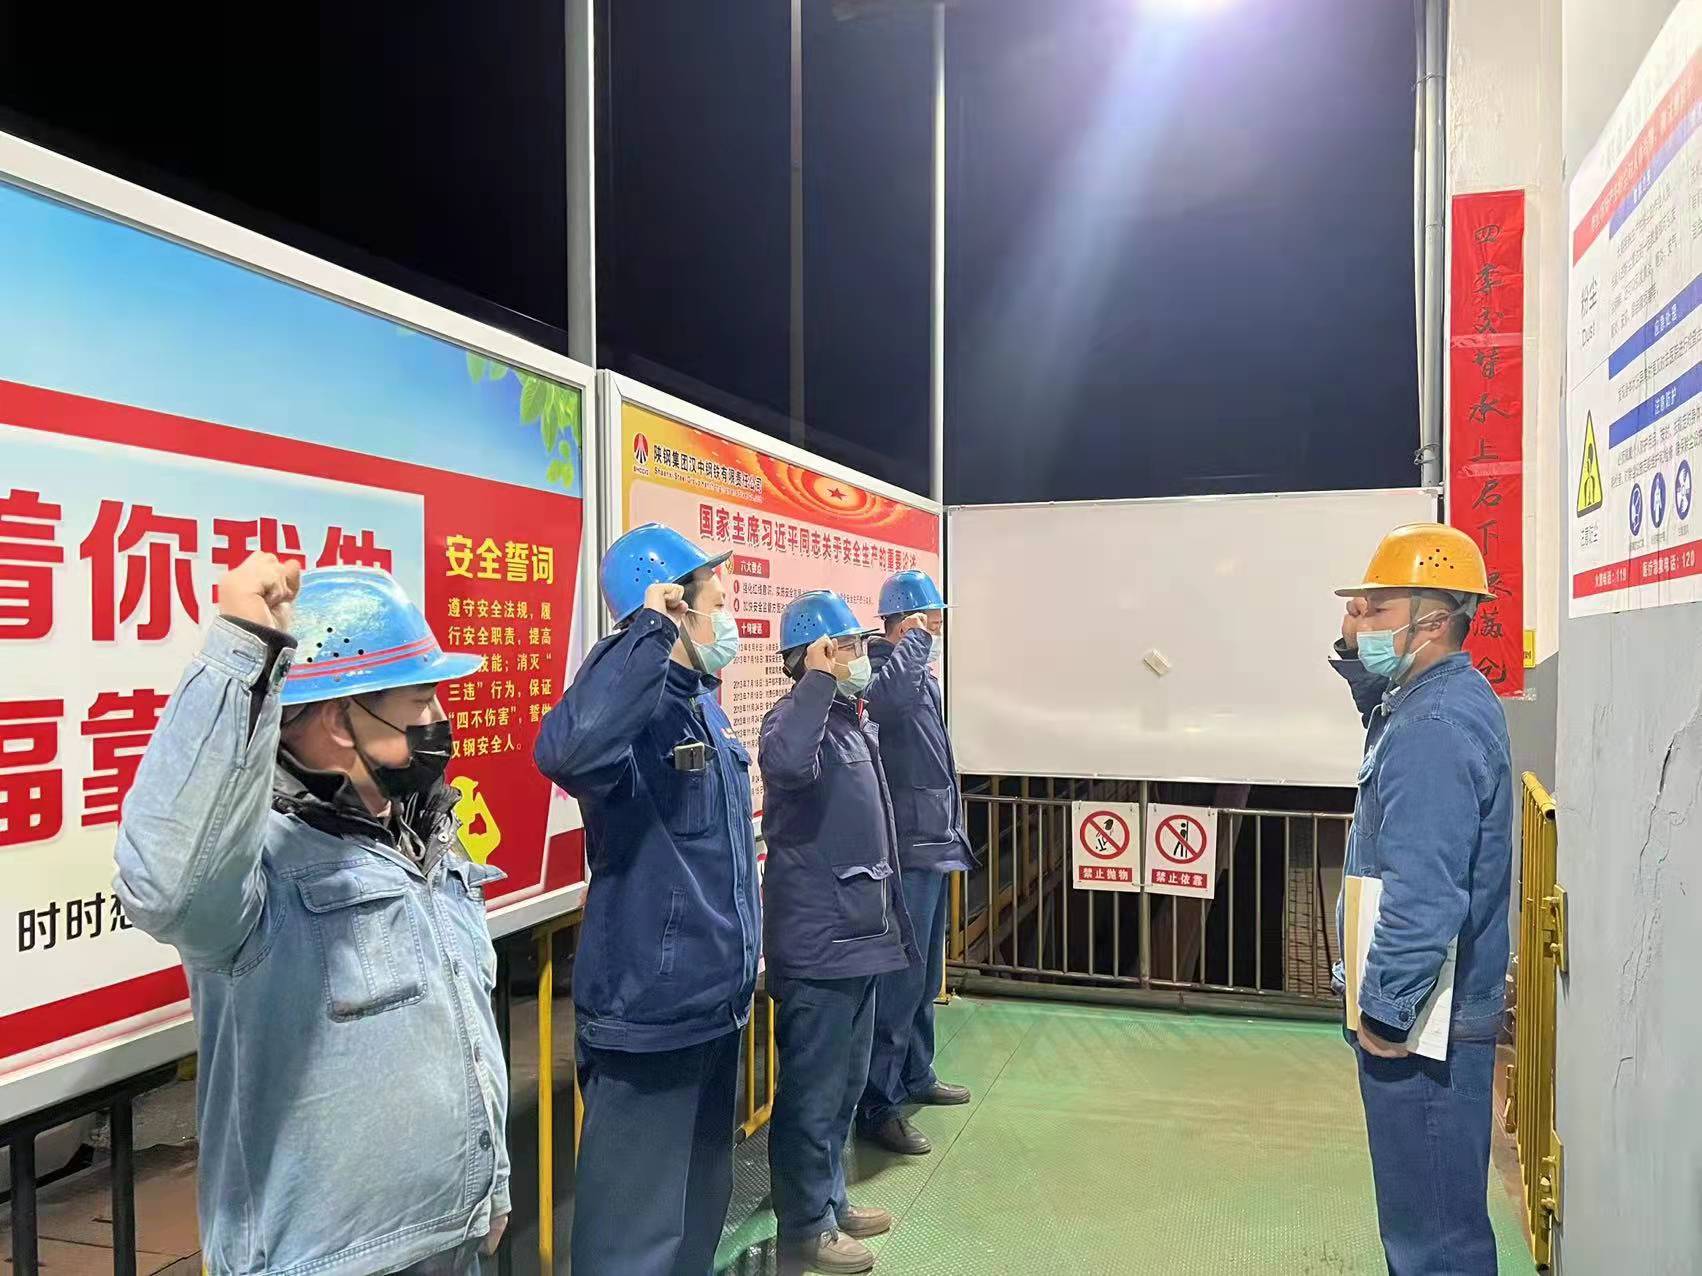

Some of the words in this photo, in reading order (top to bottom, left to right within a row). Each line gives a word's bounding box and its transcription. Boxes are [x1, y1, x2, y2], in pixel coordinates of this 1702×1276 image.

[445, 534, 554, 584] 安全誓词
[448, 598, 552, 620] 遵守安全法规，履
[448, 627, 552, 646] 行安全职责，提高
[448, 679, 552, 701] 三违”行为，保证
[1083, 868, 1129, 880] 禁止抛物
[1155, 871, 1204, 886] 禁止依靠
